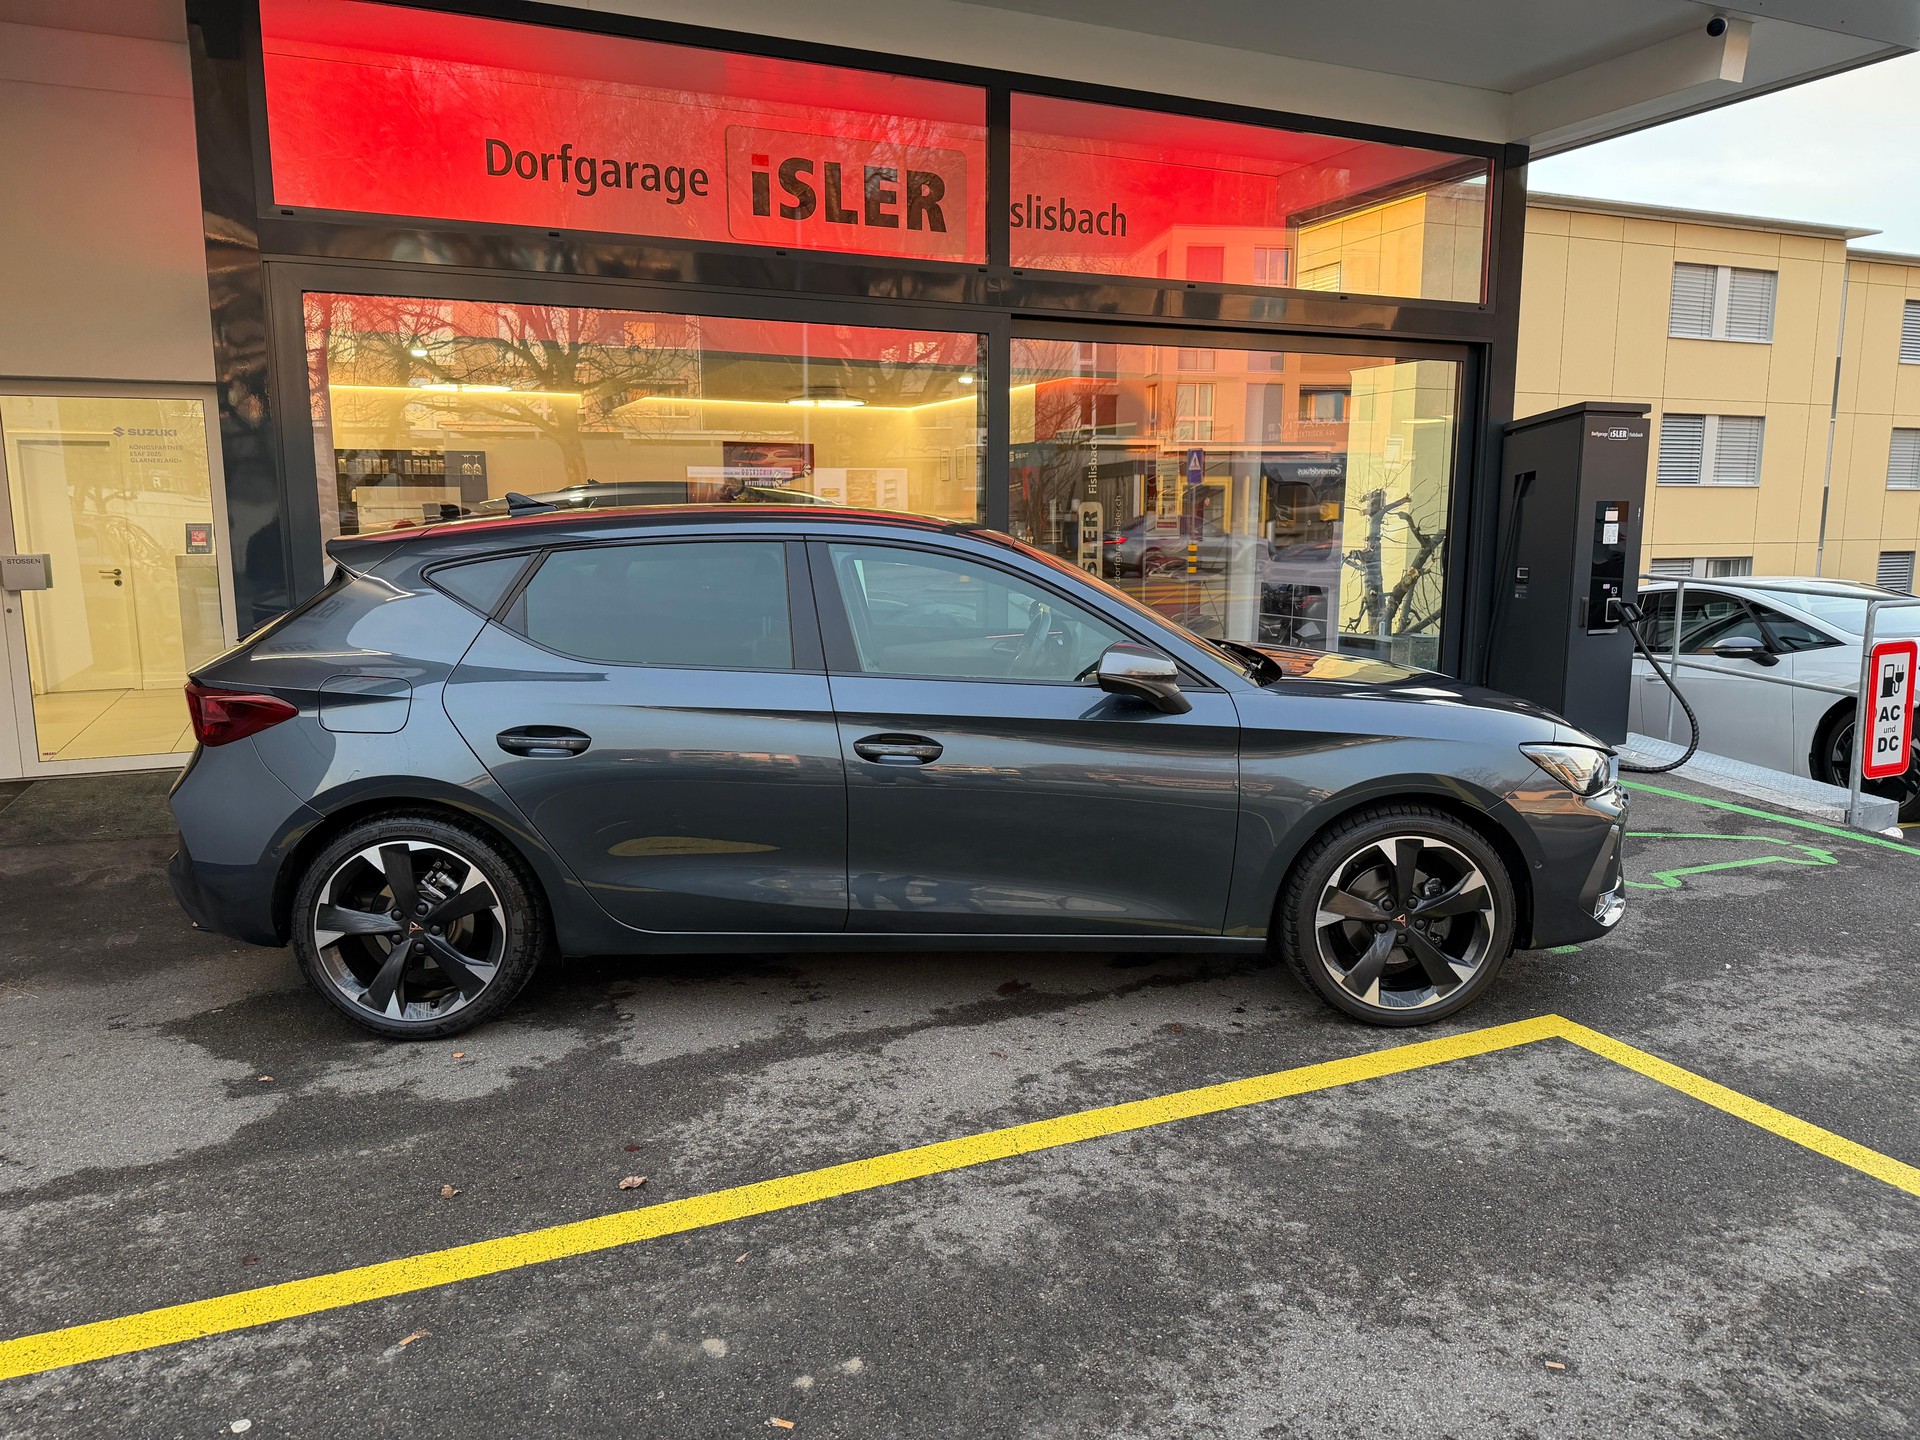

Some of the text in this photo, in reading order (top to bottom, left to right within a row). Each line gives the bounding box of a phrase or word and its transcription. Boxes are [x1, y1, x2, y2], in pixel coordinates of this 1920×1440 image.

[485, 138, 1127, 237] Dorfgarage iSLER slisbach
[127, 428, 177, 437] SUZUKI
[1082, 434, 1099, 576] SLER Fislisbach
[1878, 704, 1901, 723] AC
[1883, 725, 1896, 734] und
[1877, 735, 1899, 753] DC
[378, 825, 433, 835] BRIDGESTONE
